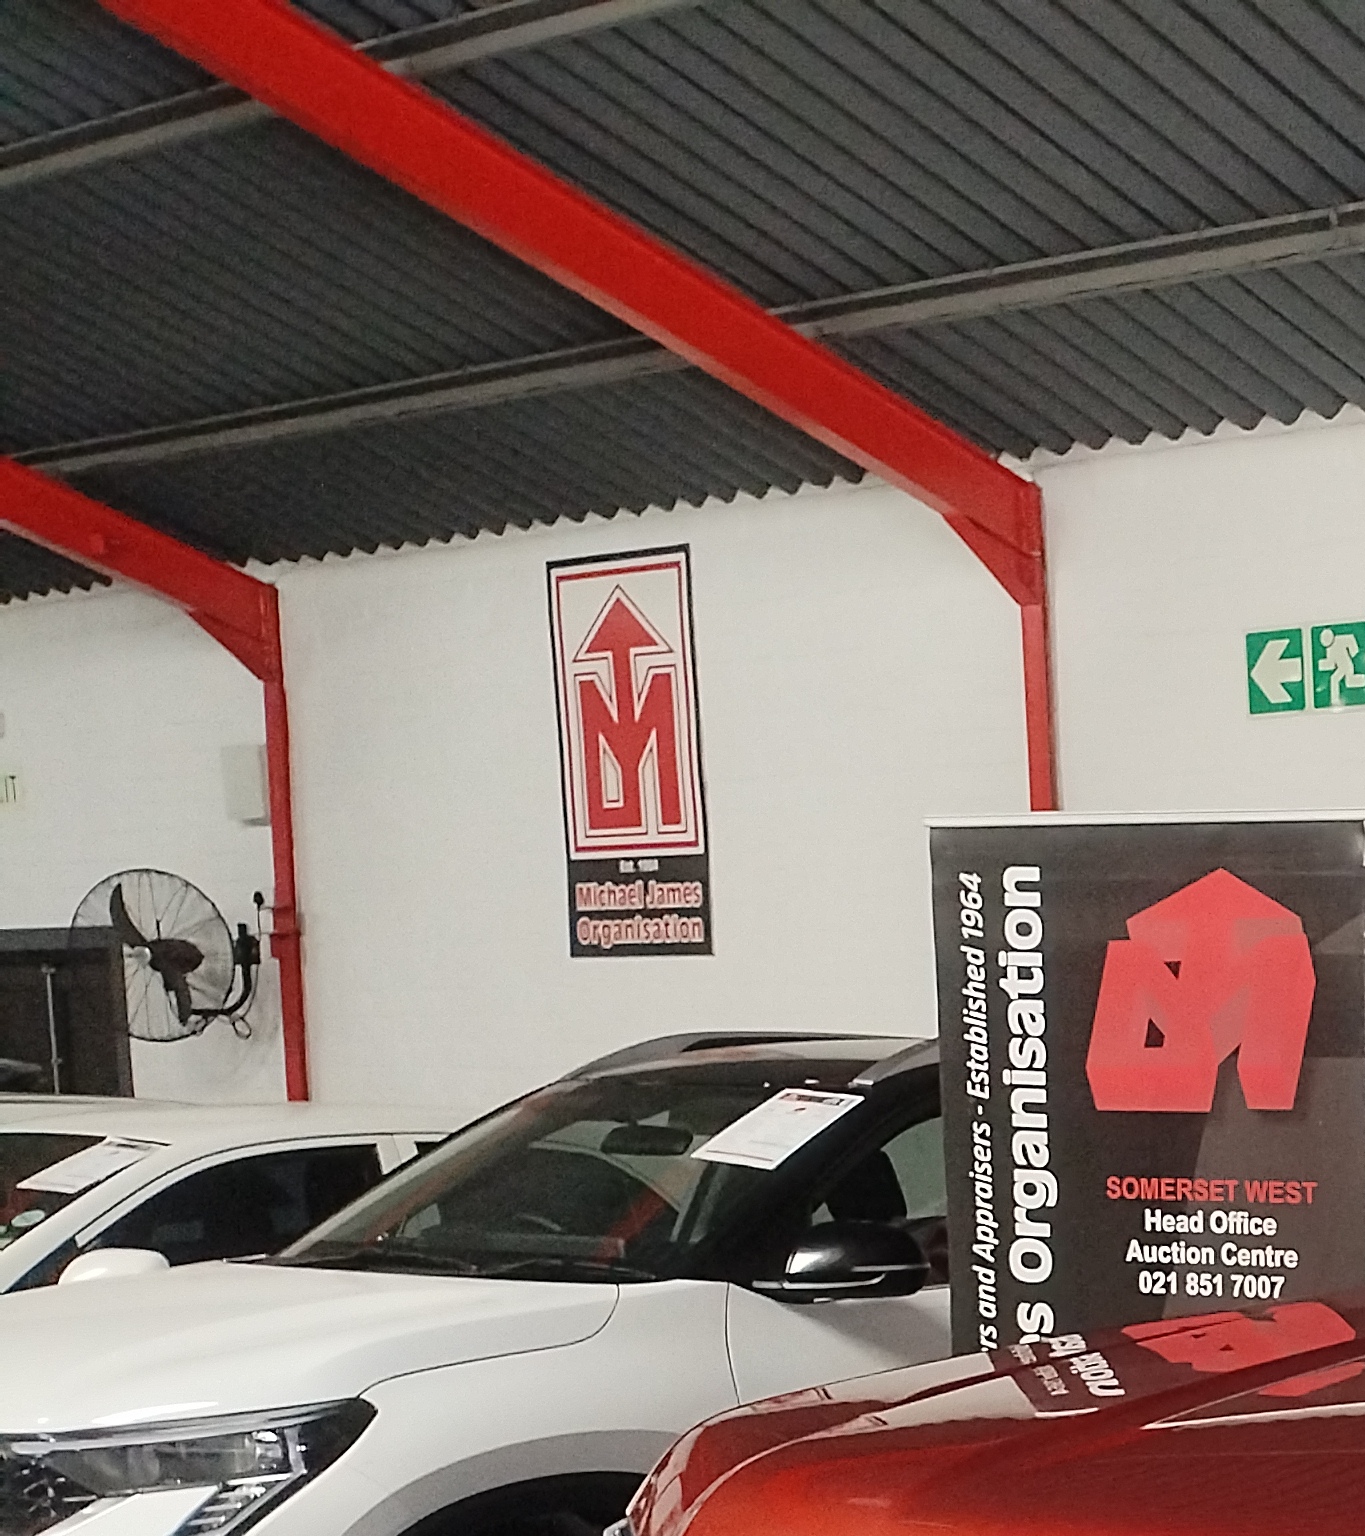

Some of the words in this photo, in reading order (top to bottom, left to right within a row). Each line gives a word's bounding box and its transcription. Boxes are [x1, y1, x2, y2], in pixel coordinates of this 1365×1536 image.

[575, 880, 644, 911] Michael
[646, 880, 702, 909] James
[959, 872, 984, 938] 1964
[577, 914, 704, 949] Organisation
[960, 946, 990, 1099] Established
[998, 865, 1059, 1283] organisation
[969, 1121, 999, 1253] Appraisers
[1106, 1175, 1239, 1202] SOMERSET
[1244, 1180, 1318, 1204] WEST
[1144, 1208, 1204, 1234] Head
[1209, 1210, 1277, 1236] Office
[1126, 1239, 1215, 1265] Auction
[1220, 1242, 1299, 1269] Centre
[971, 1264, 997, 1319] and
[1138, 1270, 1177, 1295] 021
[1185, 1273, 1223, 1297] 851
[1230, 1274, 1285, 1299] 7007
[978, 1324, 998, 1352] rs
